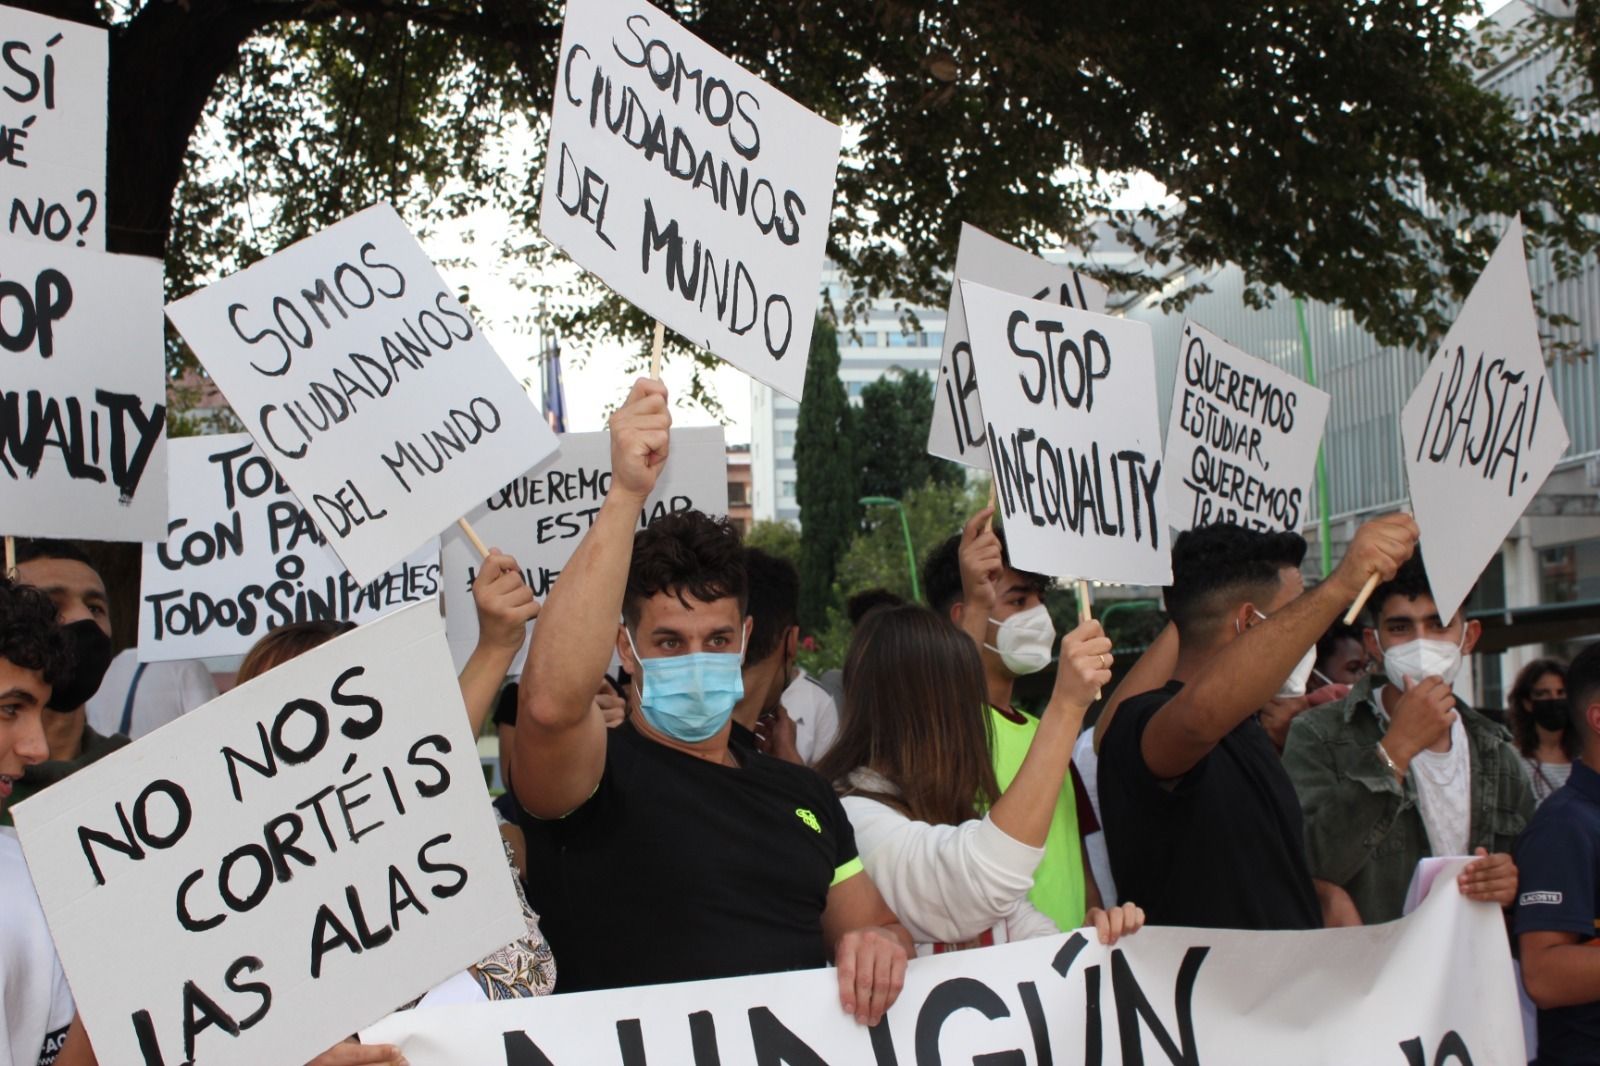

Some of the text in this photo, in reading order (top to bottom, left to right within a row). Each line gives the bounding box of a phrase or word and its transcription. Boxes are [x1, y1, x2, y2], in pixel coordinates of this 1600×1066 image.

[2, 32, 63, 110] SÍ
[612, 14, 761, 161] SOMOS
[564, 43, 806, 246] CIUDADANOS
[9, 189, 97, 247] NO?
[556, 142, 792, 360] DEL MUNDO
[228, 241, 406, 377] SOMOS
[260, 291, 474, 459] CIUDADANOS
[1007, 310, 1111, 413] STOP
[1180, 388, 1269, 472] ESTUDIAR,
[1185, 337, 1296, 434] QUEREMOS
[313, 396, 501, 538] DEL MUNDO
[987, 421, 1161, 551] INEQUALITY
[1192, 445, 1302, 531] QUEREMOS
[157, 510, 243, 570] CON
[144, 584, 264, 640] TODOS
[77, 666, 383, 886] NO NOS
[176, 734, 452, 933] CORTÉIS
[132, 833, 468, 1066] LAS ALAS
